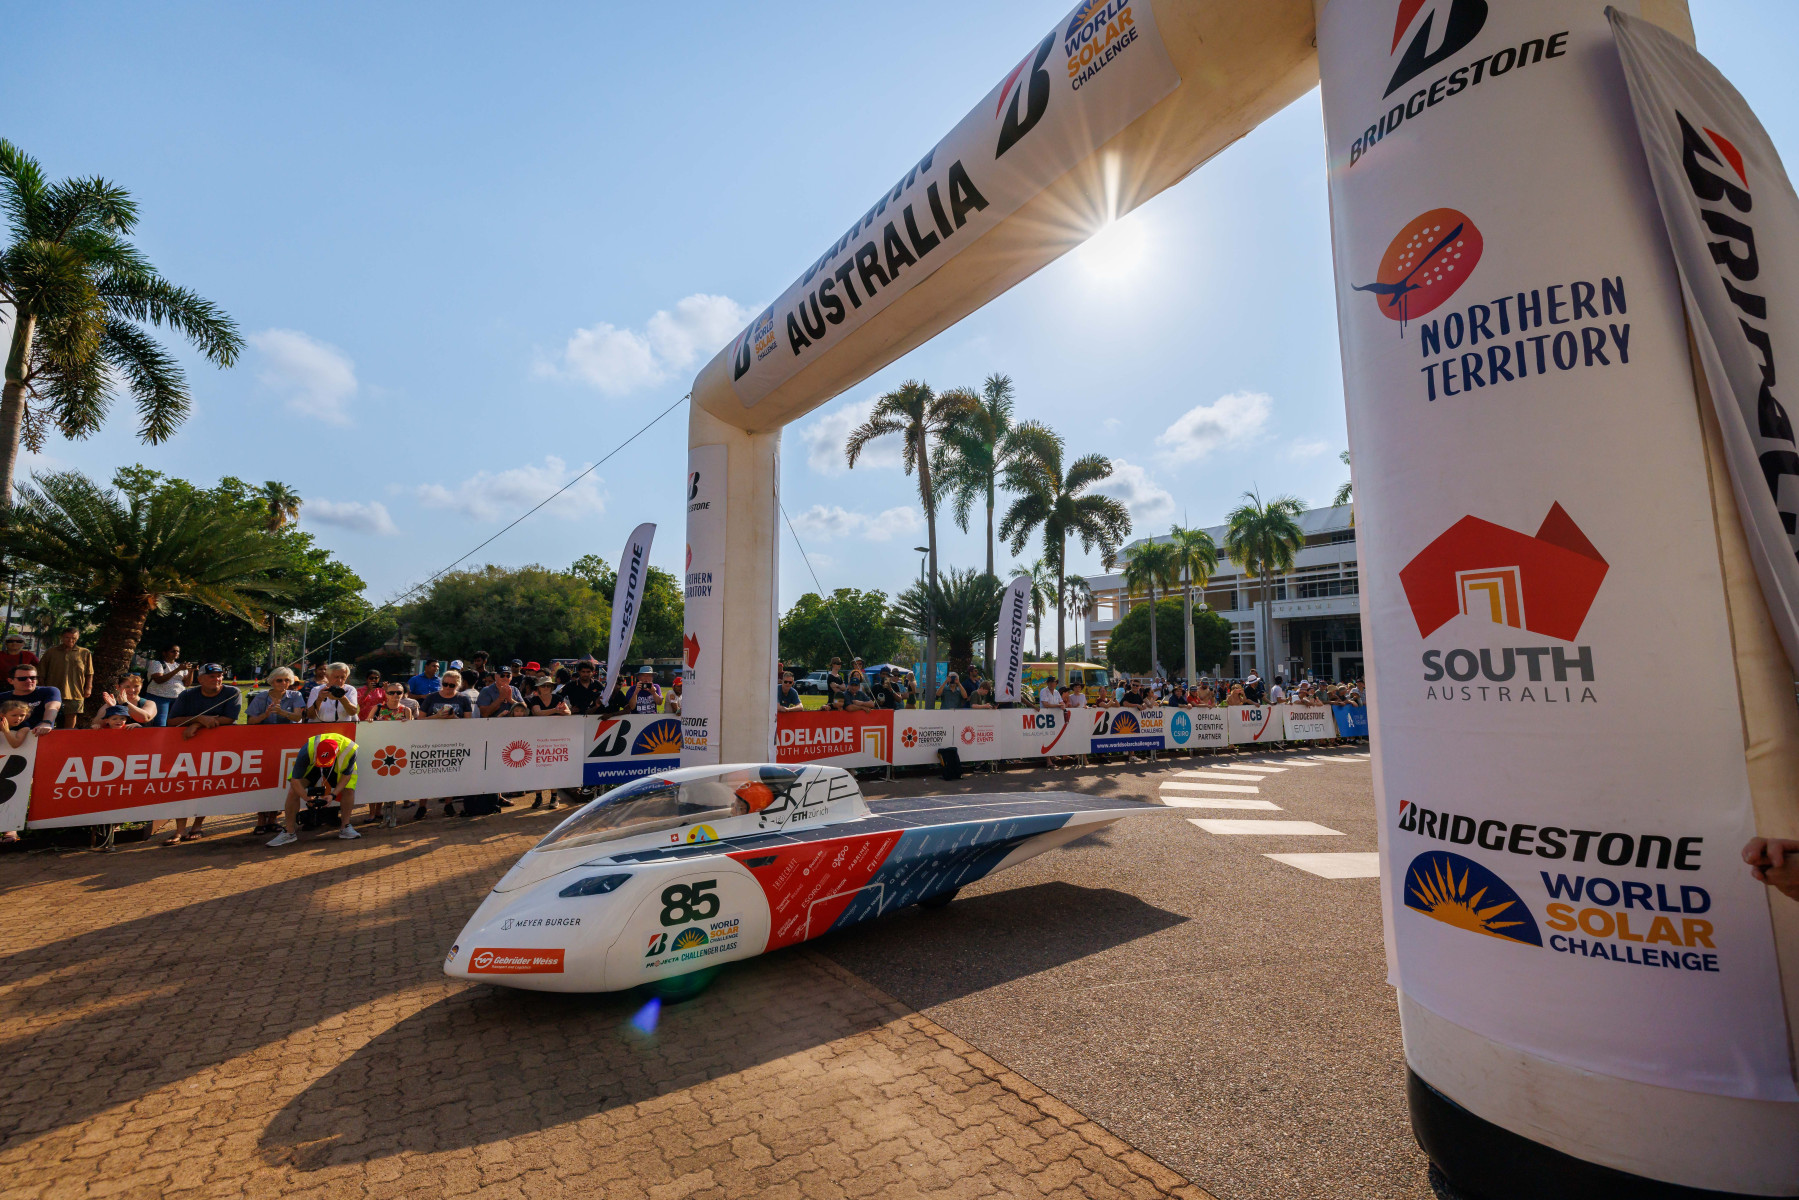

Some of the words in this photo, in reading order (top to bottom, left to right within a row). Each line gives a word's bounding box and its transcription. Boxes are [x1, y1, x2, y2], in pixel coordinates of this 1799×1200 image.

[1065, 0, 1128, 58] WORLD
[1067, 7, 1135, 78] SOLAR
[1072, 26, 1138, 91] CHALLENGE
[1350, 31, 1569, 168] BRIDGESTONE
[786, 159, 990, 356] AUSTRALIA
[1421, 276, 1627, 357] NORTHERN
[754, 320, 774, 343] WORLD
[755, 330, 775, 354] SOLAR
[757, 341, 778, 361] CHALLENGE
[1421, 323, 1631, 402] TERRITORY
[1005, 588, 1025, 698] BRIDGESTONE
[1421, 645, 1595, 682] SOUTH
[1426, 686, 1598, 704] AUSTRALIA
[1022, 713, 1056, 730] MCB
[1140, 711, 1163, 719] WORLD
[1140, 719, 1163, 728] SOLAR
[1241, 710, 1263, 722] MCB
[1290, 711, 1325, 721] BRIDGESTONE
[684, 729, 709, 738] WORLD
[918, 730, 947, 738] NORTHERN
[1195, 723, 1224, 731] SCIENTIFIC
[684, 737, 708, 746] SOLAR
[918, 736, 944, 744] TERRITORY
[410, 748, 471, 760] NORTHERN
[536, 747, 569, 756] MAJOR
[803, 744, 854, 755] AUSTRALIA
[55, 750, 264, 784] ADELAIDE
[409, 757, 464, 769] TERRITORY
[535, 755, 569, 764] EVENTS
[409, 766, 462, 775] GOVERNMENT
[53, 783, 133, 800] SOUTH
[144, 776, 261, 795] AUSTRALIA
[791, 810, 808, 822] ETH
[1398, 800, 1703, 871] BRIDGESTONE
[772, 857, 799, 890] TRIBECRAFT
[801, 883, 822, 909] ESORO
[1540, 871, 1711, 914] WORLD
[660, 879, 720, 927] 85
[515, 919, 542, 927] MEYER
[545, 918, 581, 927] BURGER
[710, 918, 740, 931] WORLD
[1545, 902, 1717, 949] SOLAR
[709, 926, 740, 938] SOLAR
[709, 933, 739, 944] CHALLENGE
[493, 956, 532, 965] Gebrüder
[532, 957, 559, 965] Weiss
[681, 945, 719, 962] CHALLENGER
[719, 942, 738, 953] CLASS
[1549, 935, 1720, 973] CHALLENGE
